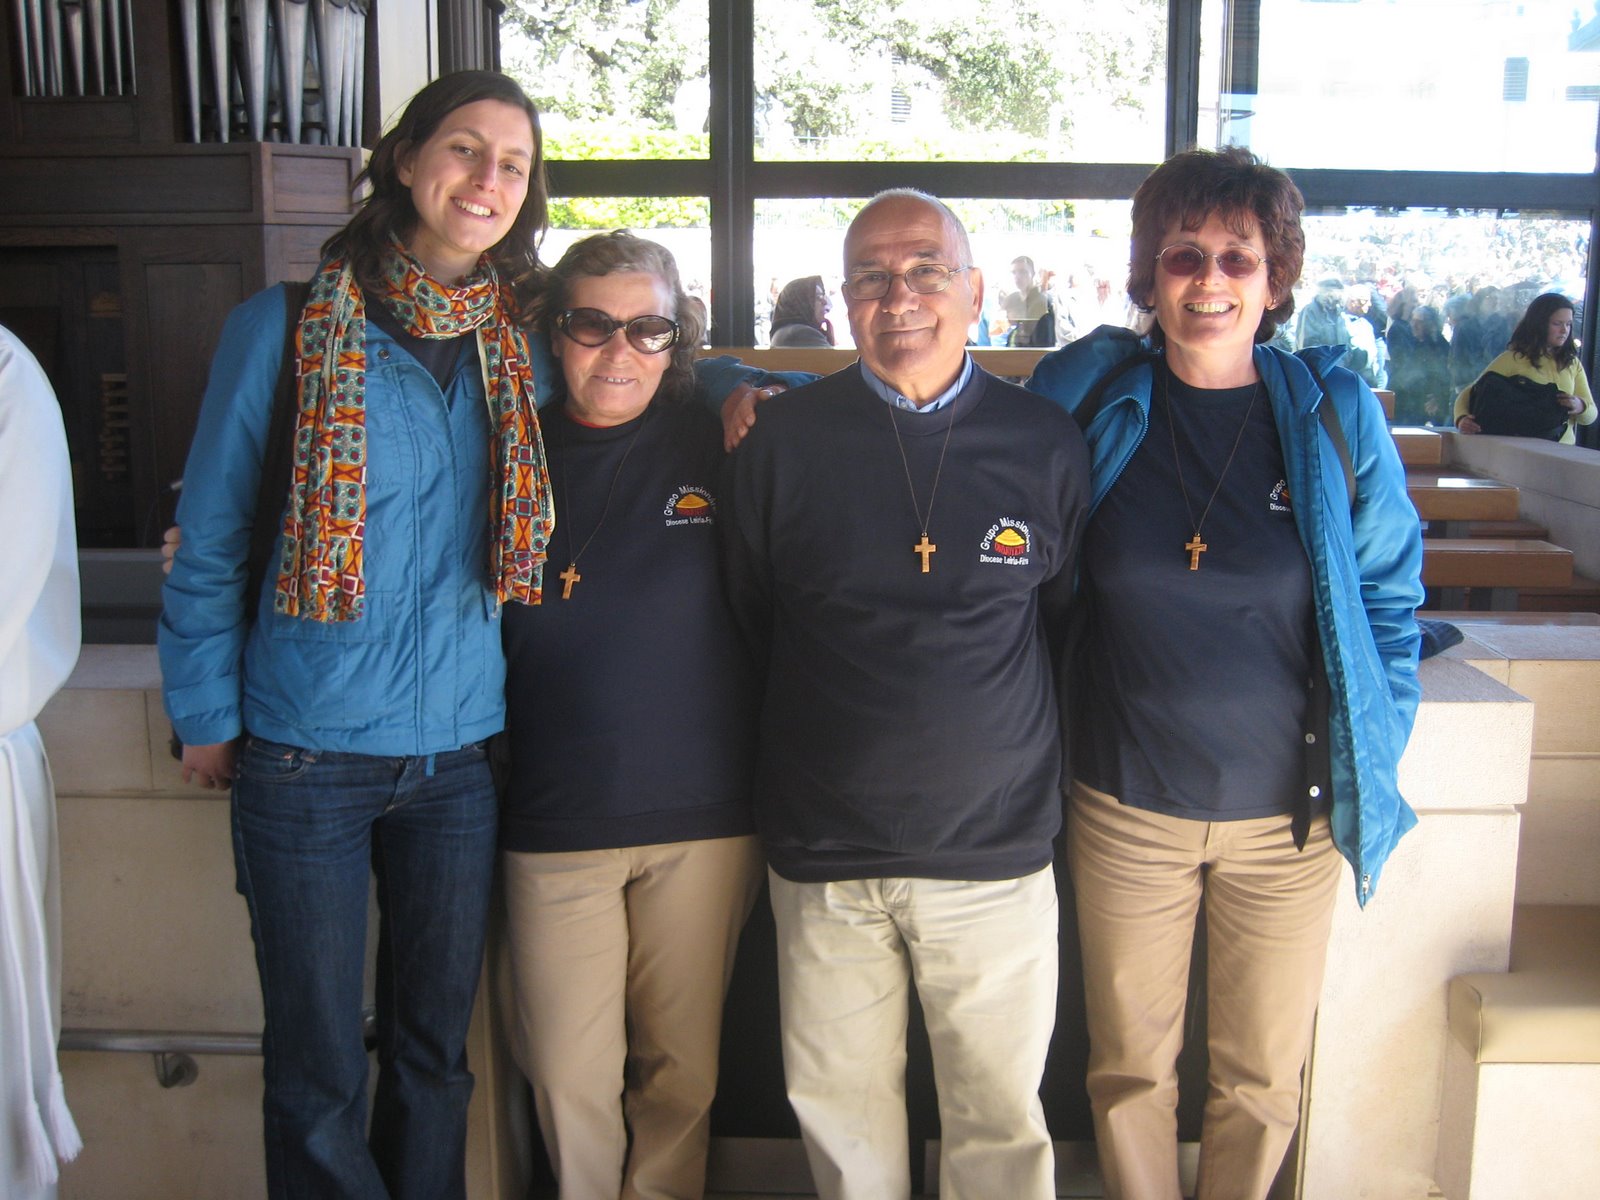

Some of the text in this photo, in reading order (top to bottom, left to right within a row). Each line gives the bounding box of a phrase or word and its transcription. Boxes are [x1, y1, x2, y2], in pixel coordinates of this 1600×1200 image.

[1269, 479, 1286, 501] Grupo
[663, 484, 717, 516] Grupo Mission
[1269, 502, 1291, 512] Dioce
[665, 518, 689, 527] Diocese
[980, 524, 999, 551] Grupo
[979, 554, 1003, 563] Diocese
